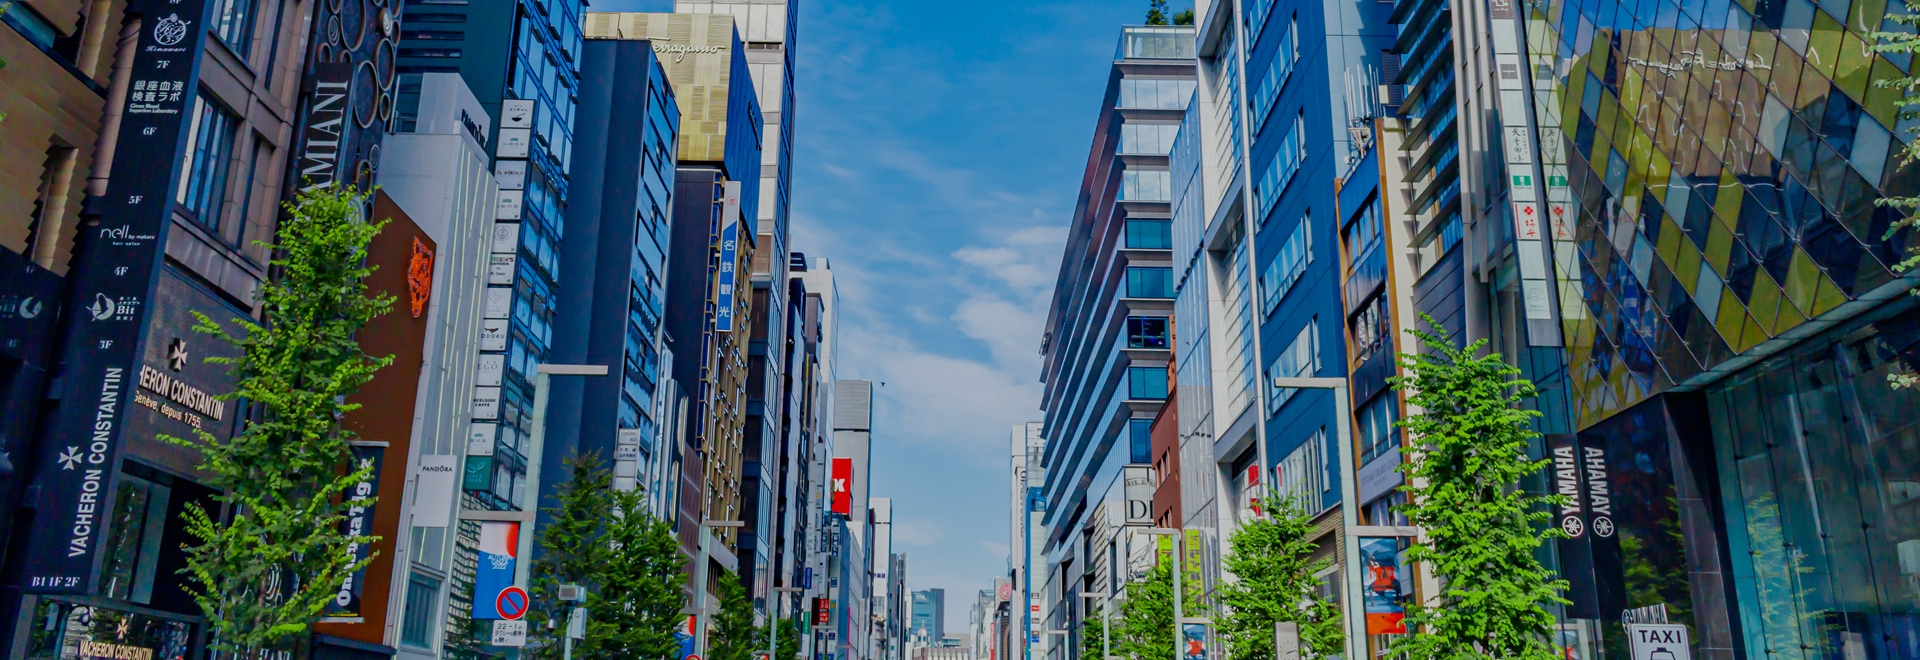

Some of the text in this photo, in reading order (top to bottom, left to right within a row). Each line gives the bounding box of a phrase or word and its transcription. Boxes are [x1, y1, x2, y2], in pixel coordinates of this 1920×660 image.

[156, 60, 170, 68] 7F
[134, 80, 184, 91] 銀座血液
[132, 92, 181, 102] 検査ラボ
[143, 127, 157, 135] 6F
[128, 196, 143, 204] 5F
[100, 224, 129, 238] nell
[114, 266, 128, 276] 4F
[718, 240, 734, 318] 名鉄観光
[116, 306, 135, 314] Bit
[98, 340, 113, 349] 3F
[171, 380, 224, 420] CONSTANTIN
[88, 368, 123, 464] CONSTANTIN
[161, 402, 182, 420] depuis
[68, 470, 102, 558] VACHERON
[32, 576, 80, 587] B1 1F 2F
[1638, 630, 1682, 643] TAXI
[80, 640, 116, 658] VACHERON
